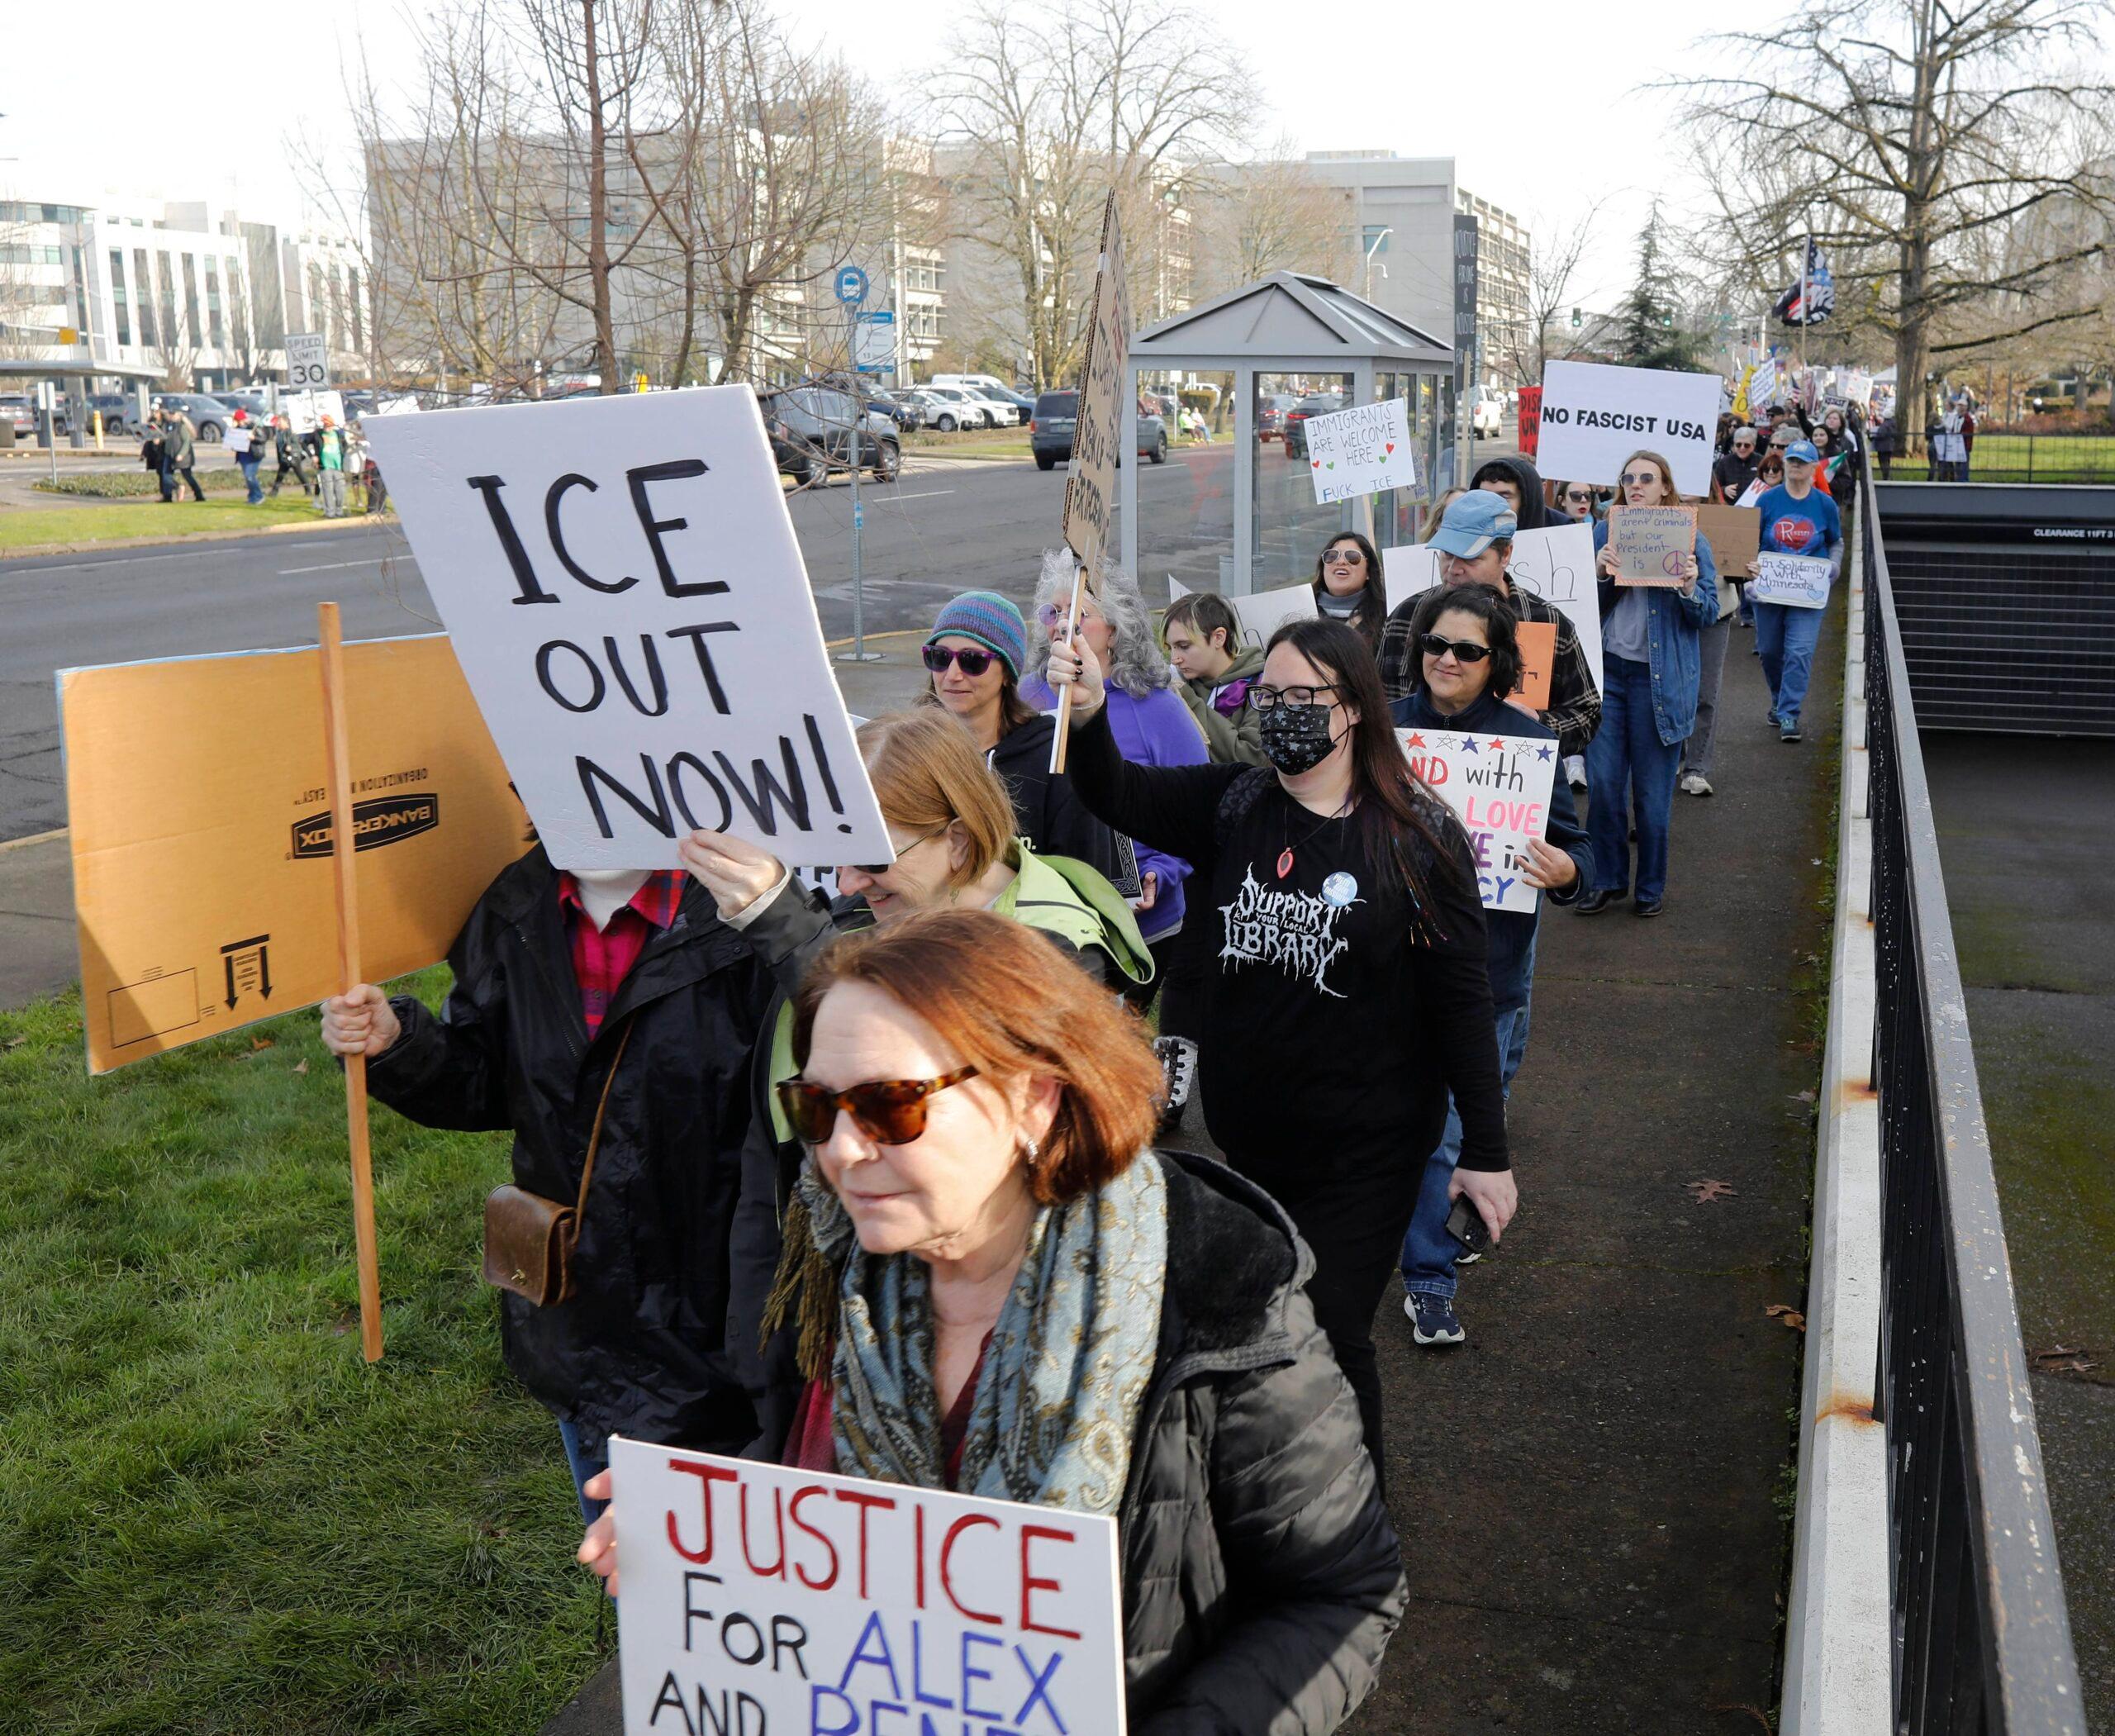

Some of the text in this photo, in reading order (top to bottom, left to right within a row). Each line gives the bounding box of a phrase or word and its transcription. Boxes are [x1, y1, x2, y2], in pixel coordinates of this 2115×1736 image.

[287, 338, 321, 348] SPEED
[292, 350, 318, 361] LIMIT
[293, 364, 324, 384] 30
[1309, 403, 1393, 436] IMMIGRANTS
[1542, 407, 1706, 440] NO FASCIST USA
[1313, 421, 1396, 455] ARE WELCOME
[1347, 446, 1373, 466] HERE
[1323, 475, 1395, 502] FUCK ICE
[1618, 506, 1681, 520] Immigrants
[467, 459, 730, 605] ICE
[1620, 530, 1637, 540] but
[2033, 529, 2084, 538] CLEARANCE
[1617, 541, 1671, 553] President
[1633, 556, 1645, 568] is
[1760, 558, 1825, 578] In Solidarity
[1758, 574, 1815, 591] Minnesota
[536, 622, 740, 716] OUT
[359, 768, 428, 792] ORGANIZATION
[576, 714, 852, 839] NOW!
[1466, 752, 1523, 792] with
[1466, 795, 1542, 836] LOVE
[1504, 844, 1529, 873] in
[1237, 862, 1366, 945] SUPPORT
[1256, 912, 1308, 934] YOUR LOCAL
[1217, 901, 1348, 998] LIBRARY
[667, 1458, 1081, 1639] JUSTICE
[683, 1571, 808, 1680] FOR
[839, 1610, 1068, 1735] ALEX
[649, 1670, 766, 1736] AND
